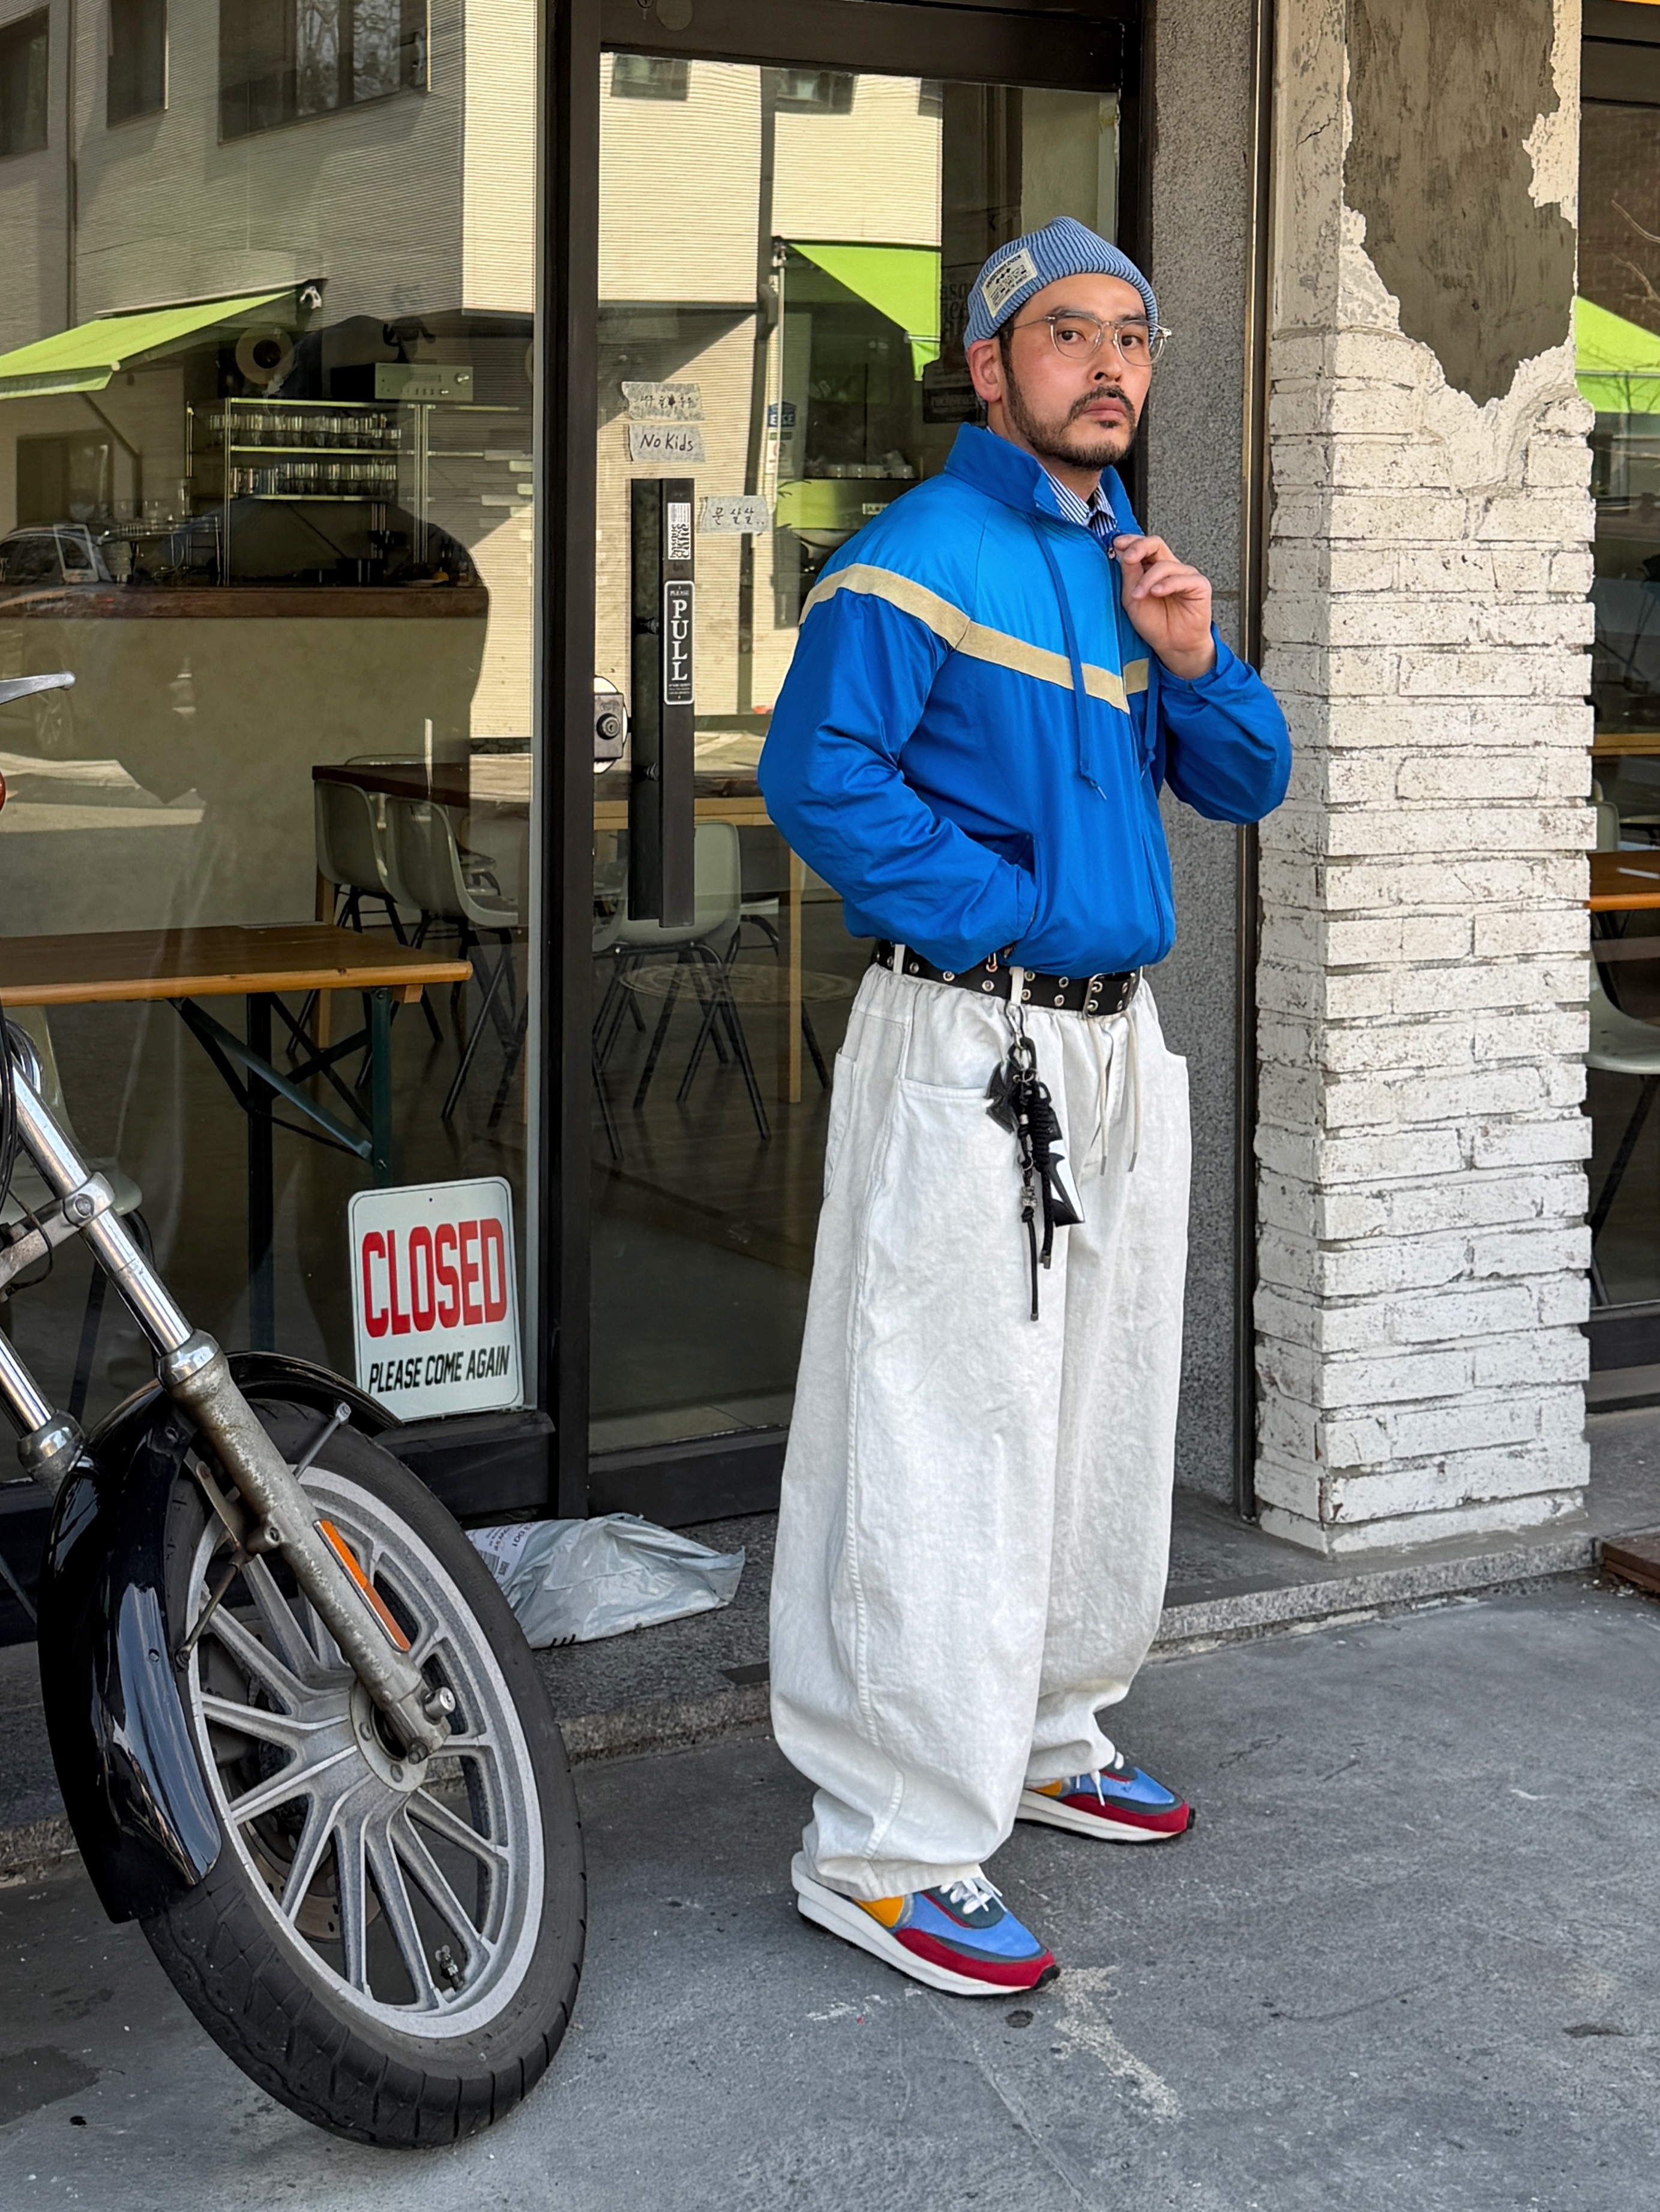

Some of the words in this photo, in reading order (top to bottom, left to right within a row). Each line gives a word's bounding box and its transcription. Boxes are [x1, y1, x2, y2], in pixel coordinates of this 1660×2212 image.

[640, 434, 661, 448] No
[666, 432, 694, 451] Kids
[712, 506, 724, 525] 문
[670, 600, 690, 681] PULL
[362, 1218, 507, 1338] CLOSED
[368, 1357, 423, 1394] PLEASE
[425, 1350, 465, 1386] COME
[466, 1345, 511, 1381] AGAIN
